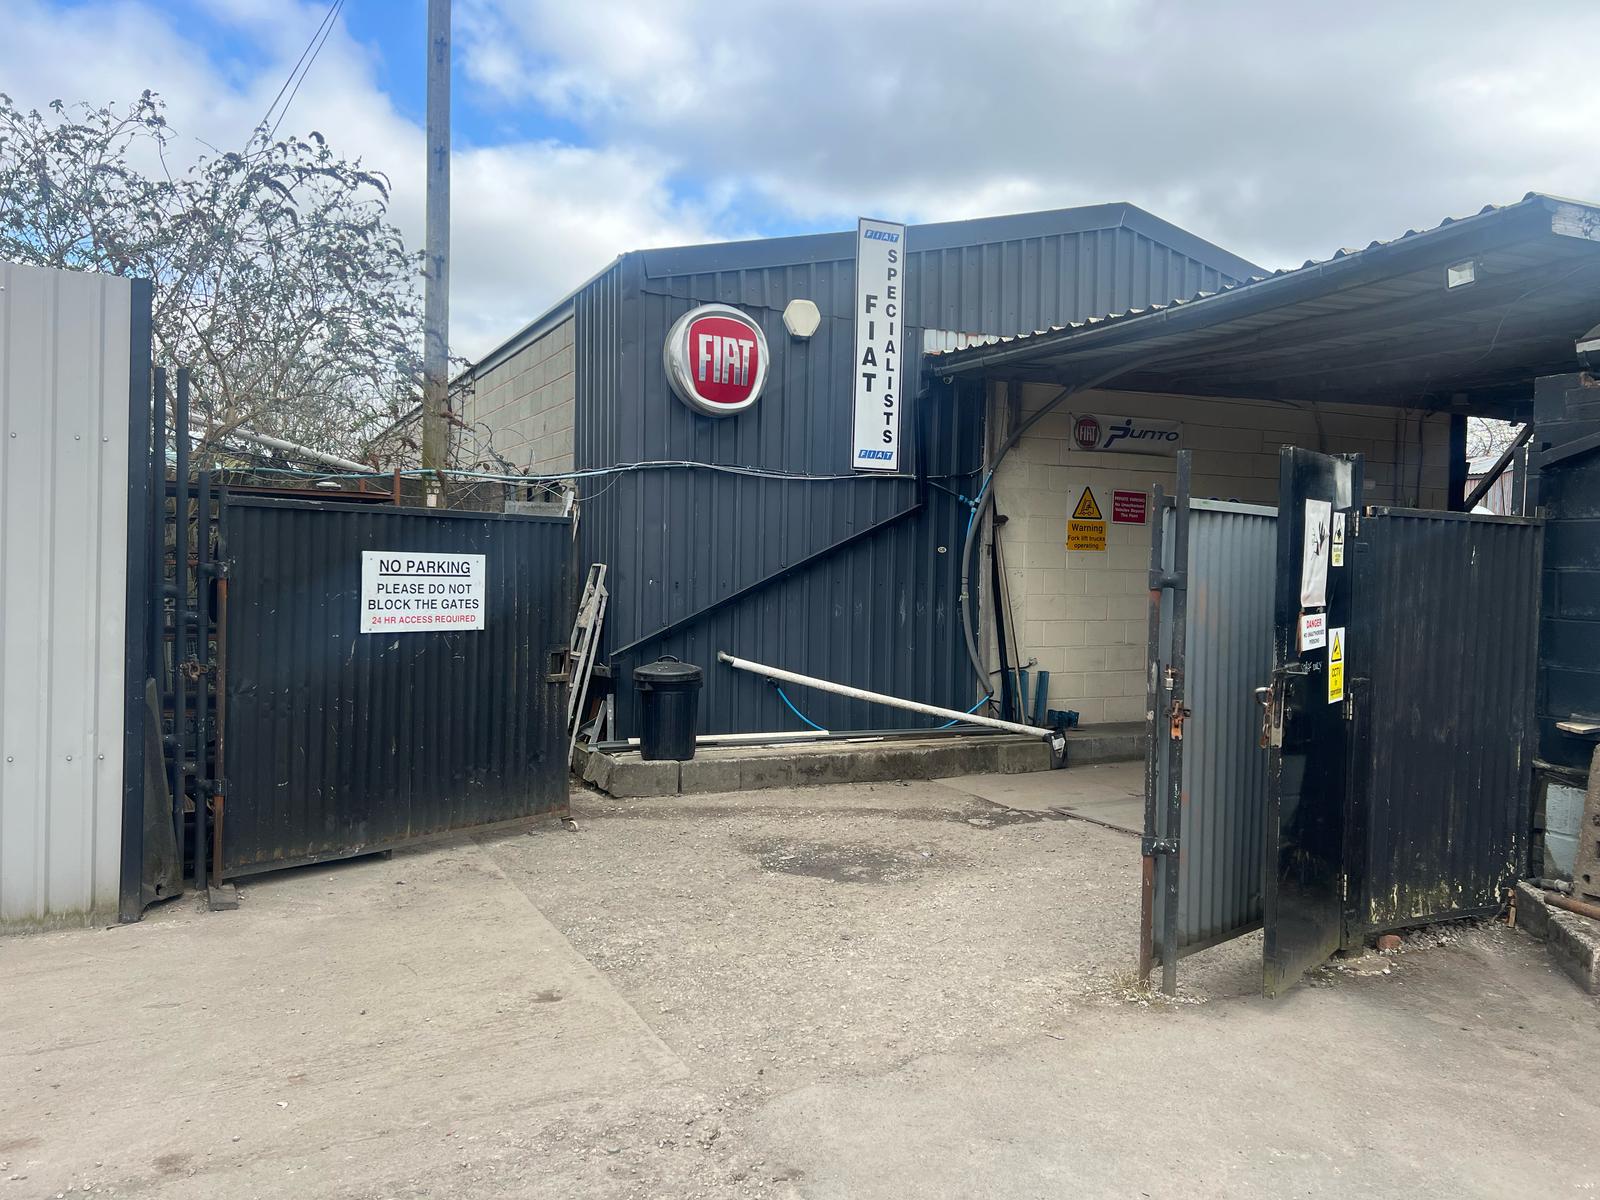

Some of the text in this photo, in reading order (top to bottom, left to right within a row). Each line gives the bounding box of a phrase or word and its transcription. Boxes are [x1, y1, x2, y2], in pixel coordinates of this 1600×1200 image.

[864, 230, 899, 242] FIAT
[861, 294, 878, 392] FIAT
[882, 249, 898, 444] SPECIALISTS
[698, 333, 754, 386] FIAT
[1079, 425, 1096, 442] FIAT
[858, 450, 893, 460] FIAT
[1071, 523, 1103, 534] Warning
[379, 559, 471, 574] NO PARKING
[377, 583, 472, 594] PLEASE DO NOT
[368, 599, 479, 610] BLOCK THE GATES
[372, 615, 476, 624] 24 HR ACCESS REQUIRED
[1306, 618, 1322, 629] DANGER
[1331, 667, 1341, 677] CCTV
